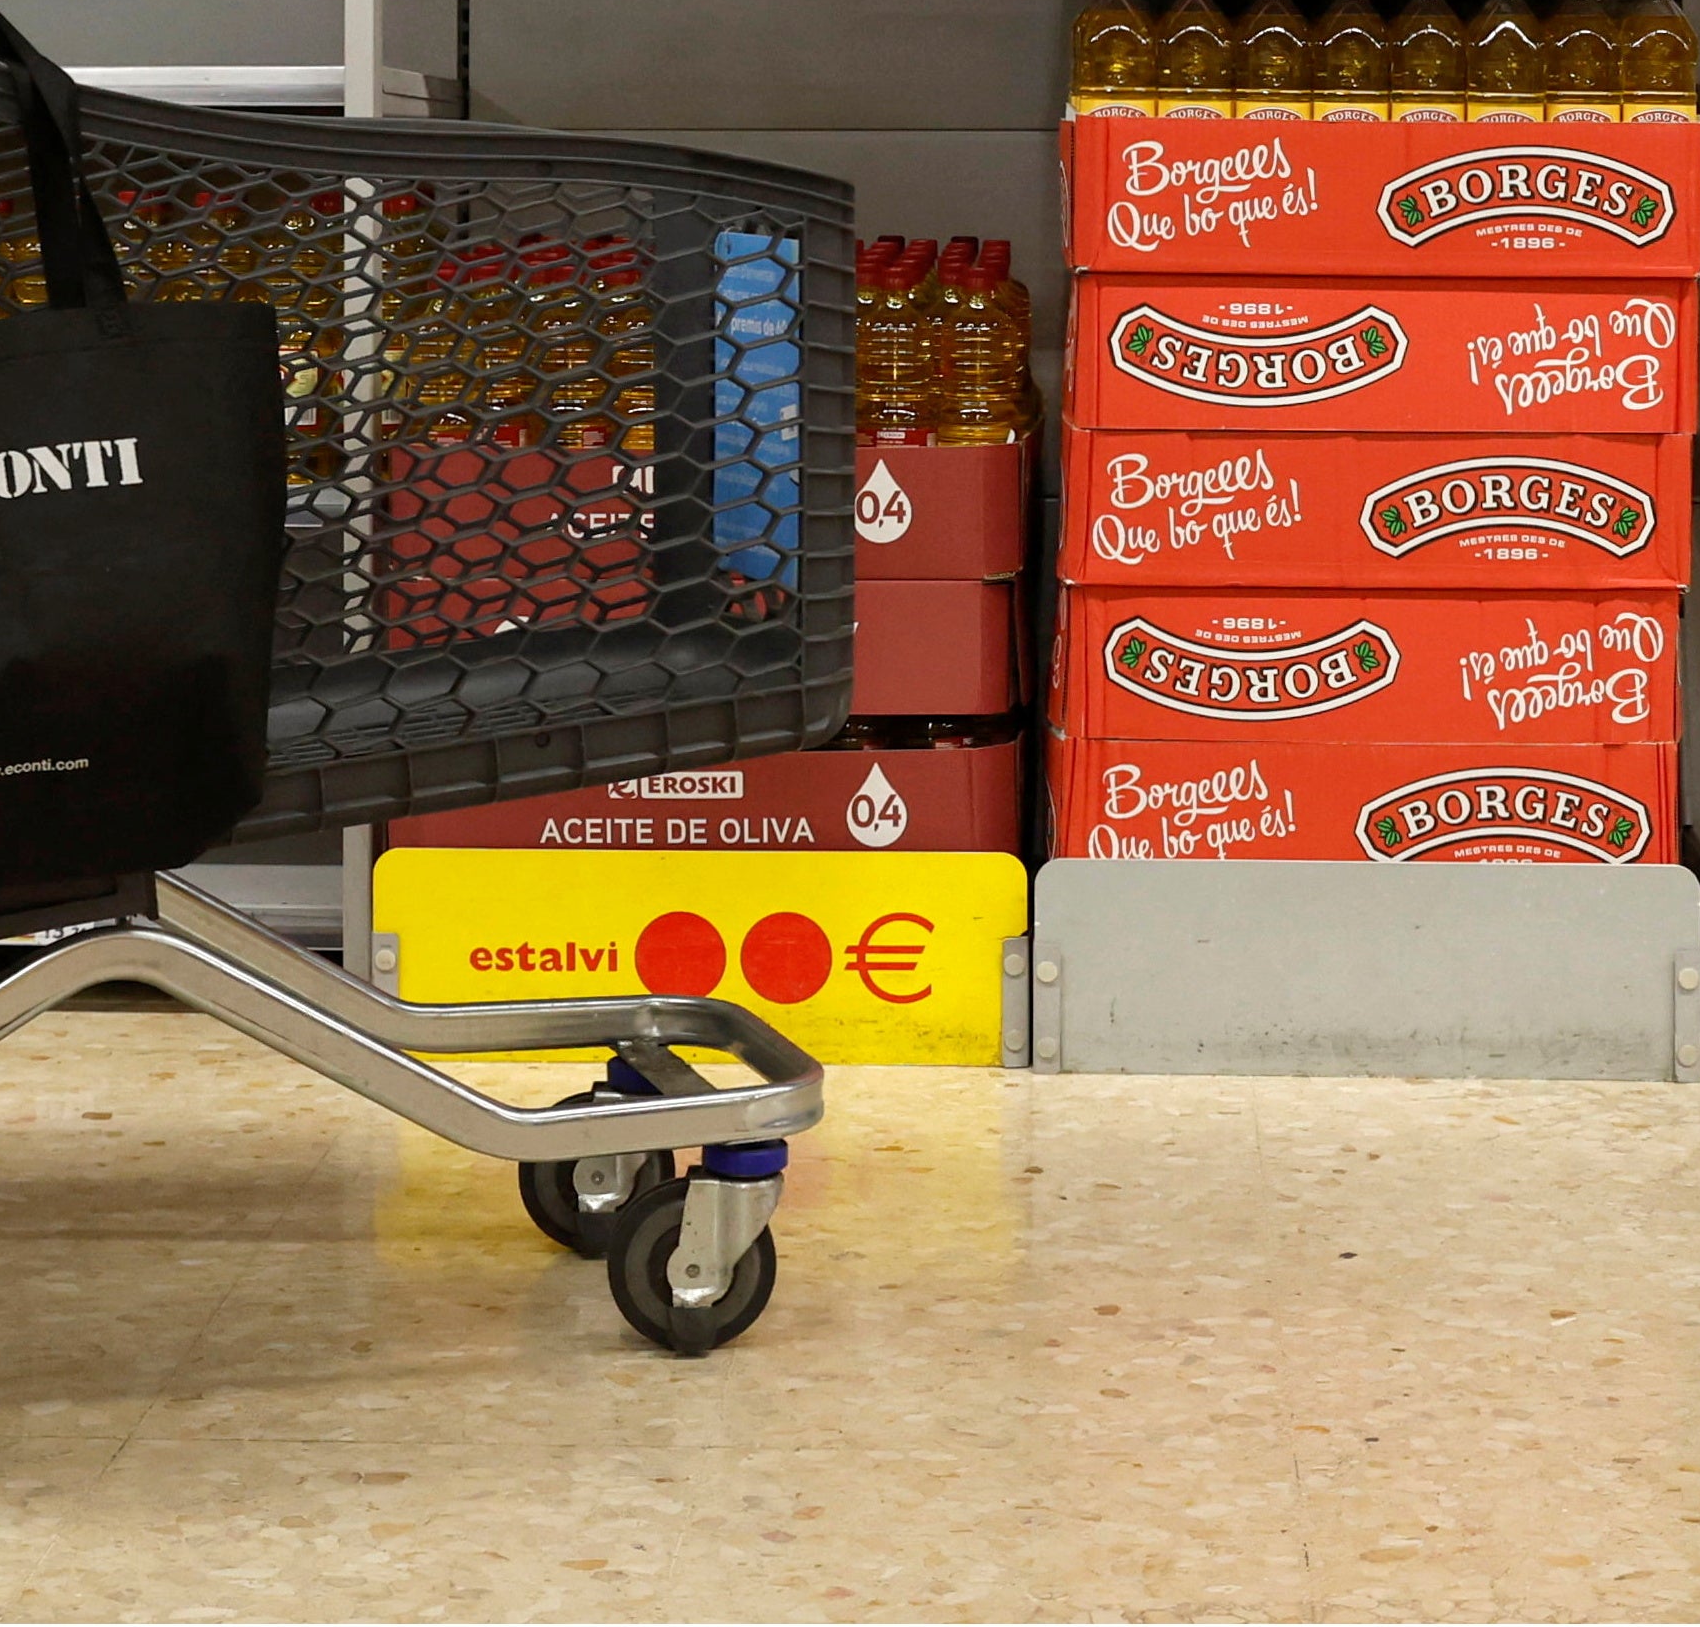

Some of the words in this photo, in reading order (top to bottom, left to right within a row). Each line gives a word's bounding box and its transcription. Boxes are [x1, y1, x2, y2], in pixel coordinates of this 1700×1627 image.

[1108, 201, 1175, 251] Que
[1184, 194, 1223, 235] bo
[1229, 196, 1277, 247] que
[1283, 168, 1317, 215] és!
[1419, 164, 1633, 217] BORGES
[1475, 224, 1535, 237] MESTRES
[1537, 223, 1564, 233] DES
[1566, 227, 1583, 238] DE
[1507, 304, 1556, 355] que
[1561, 315, 1601, 357] bo
[1609, 298, 1675, 348] Que
[1151, 335, 1364, 388] BORGES
[1093, 515, 1160, 564] Que
[1169, 507, 1207, 548] bo
[1213, 508, 1261, 559] que
[1266, 479, 1302, 527] és!
[1403, 474, 1615, 528] BORGES
[1500, 618, 1548, 671] que
[1553, 629, 1593, 671] bo
[1599, 613, 1663, 662] Que
[1144, 649, 1357, 702] BORGES
[648, 776, 737, 795] EROSKI
[1398, 785, 1609, 838] BORGES
[540, 817, 654, 845] ACEITE
[667, 818, 707, 843] DE
[719, 817, 815, 845] OLIVA
[1162, 817, 1202, 858] bo
[1207, 815, 1255, 860] que
[1260, 790, 1296, 837] és!
[469, 941, 618, 973] estalvi
